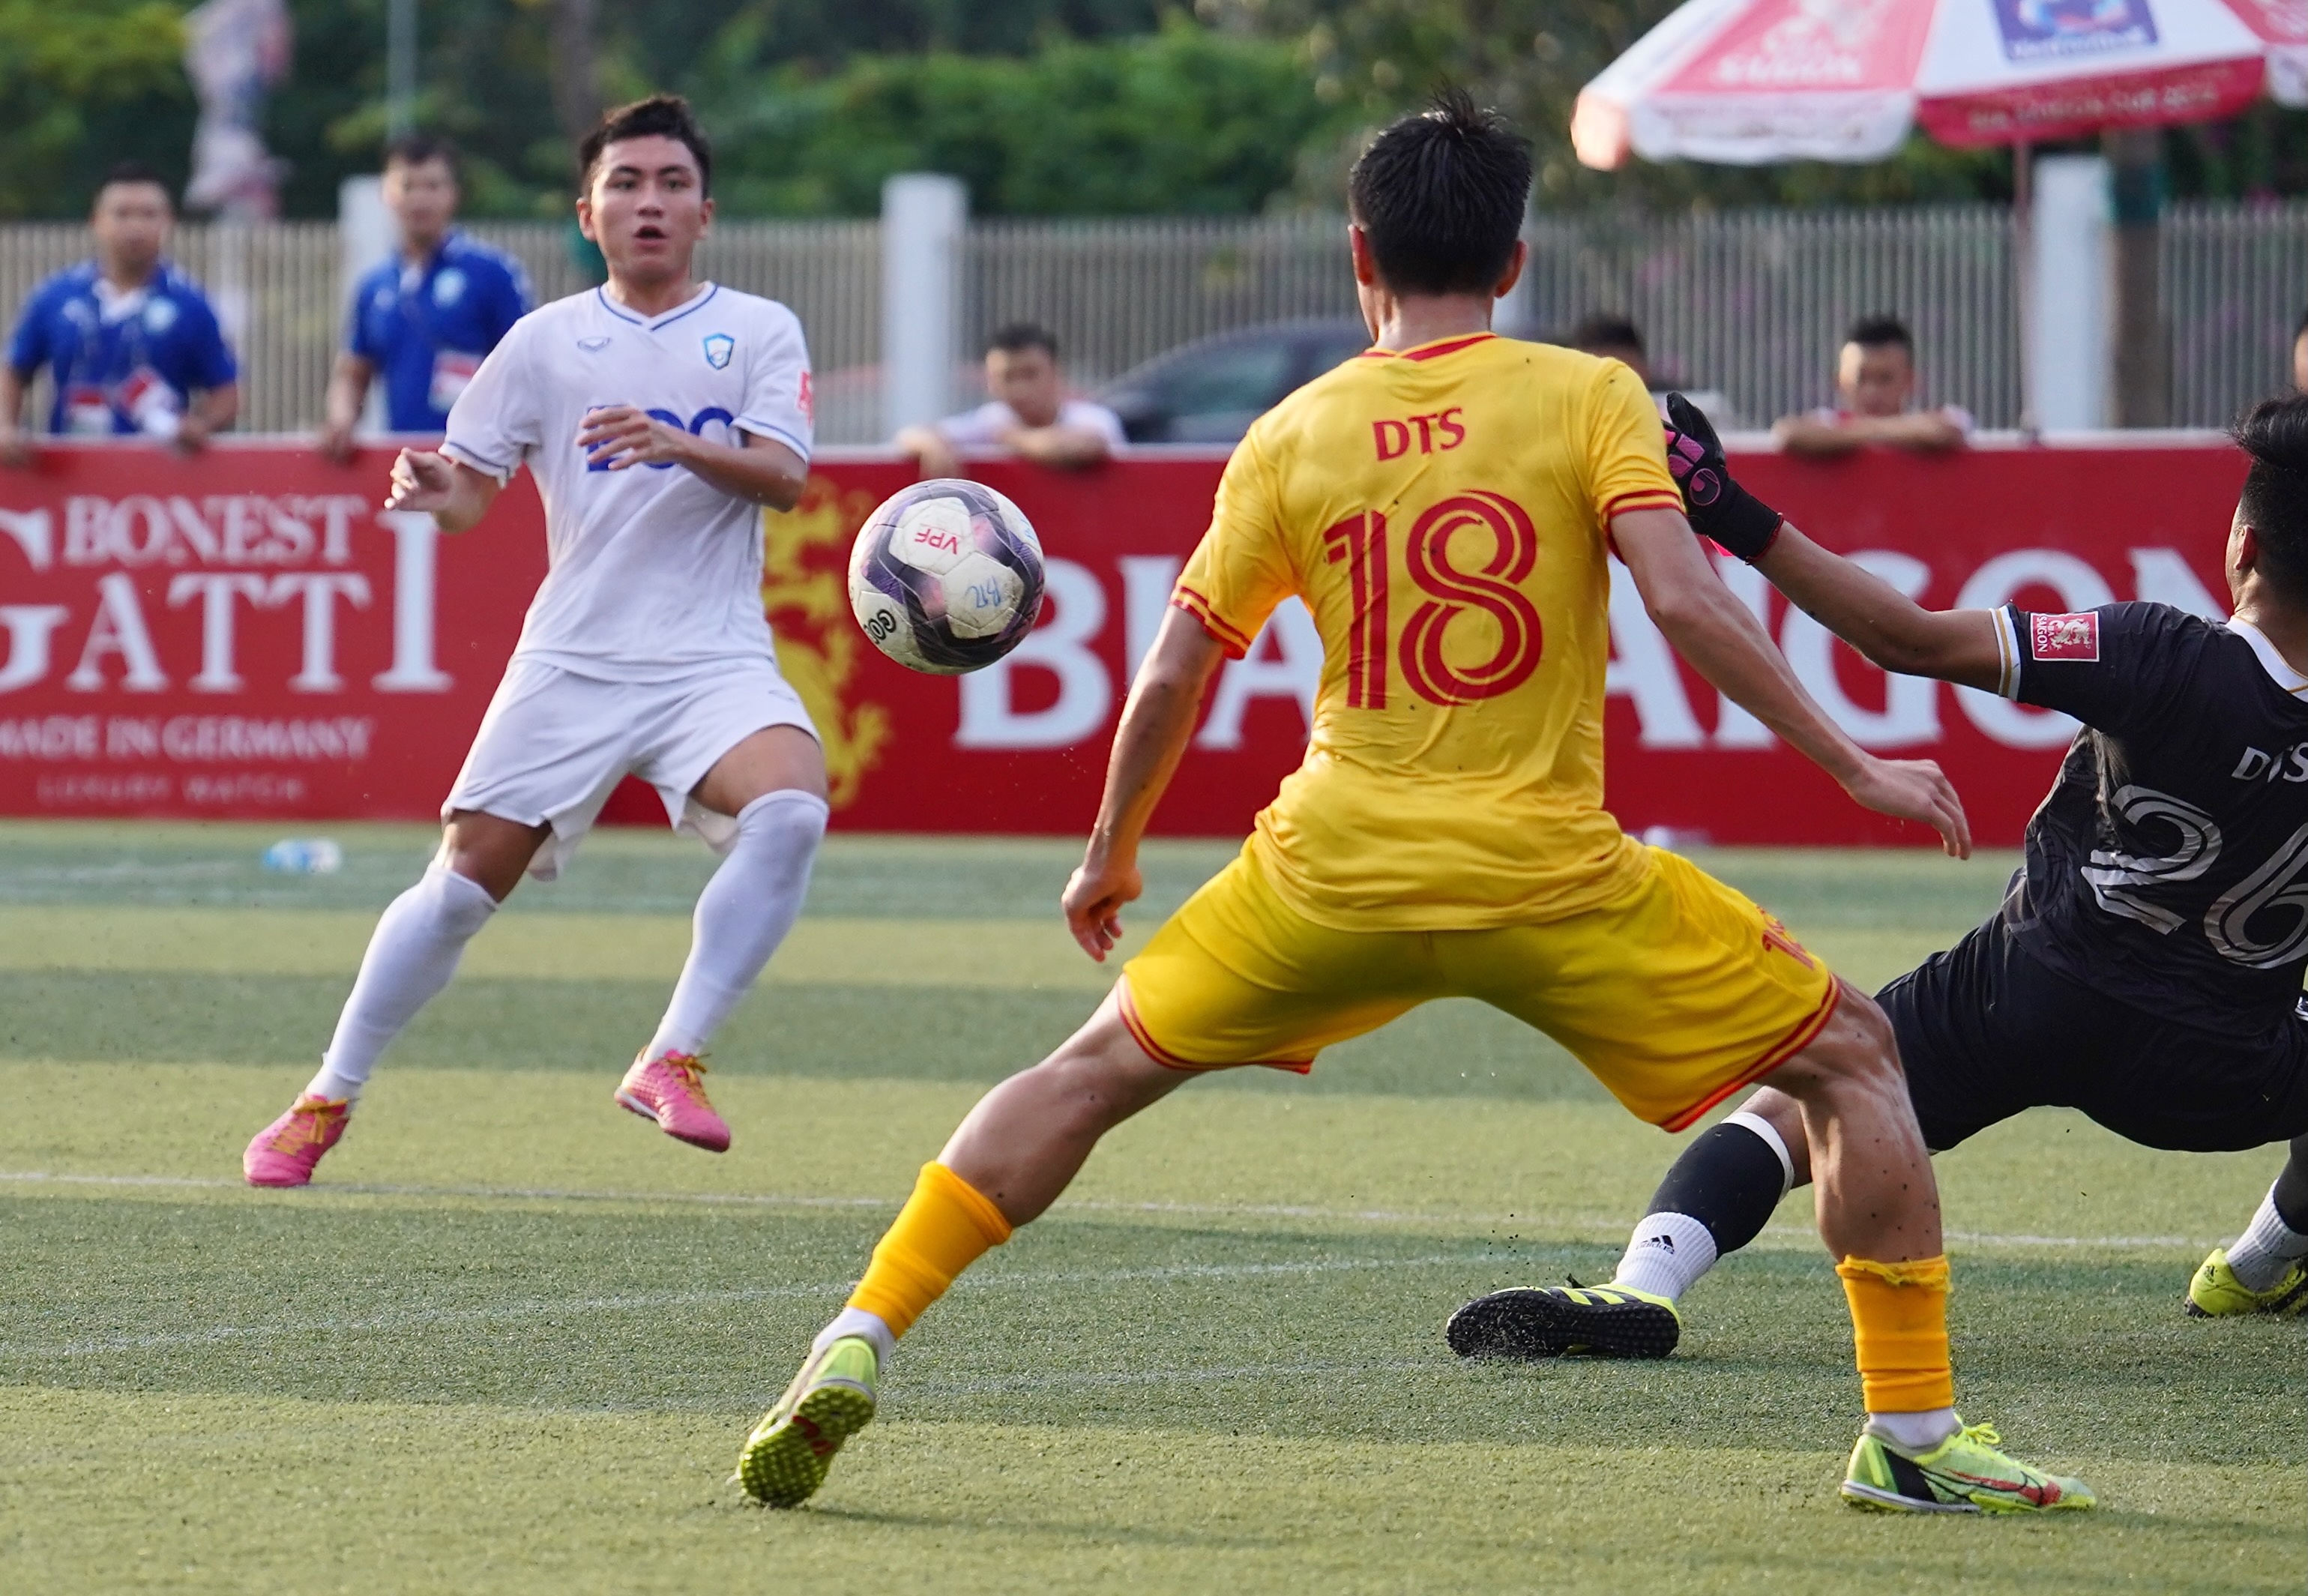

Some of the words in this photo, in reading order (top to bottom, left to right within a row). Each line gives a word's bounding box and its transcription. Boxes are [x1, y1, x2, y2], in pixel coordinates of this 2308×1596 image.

[1373, 407, 1466, 462] DTS
[63, 495, 368, 566] BONEST
[915, 528, 959, 555] VPF
[1322, 489, 1543, 710] 18
[2036, 615, 2049, 653] SAIGON
[106, 714, 160, 760] IN
[160, 714, 375, 762] GERMANY
[2081, 783, 2308, 969] 26
[1636, 1239, 1675, 1255] adidas
